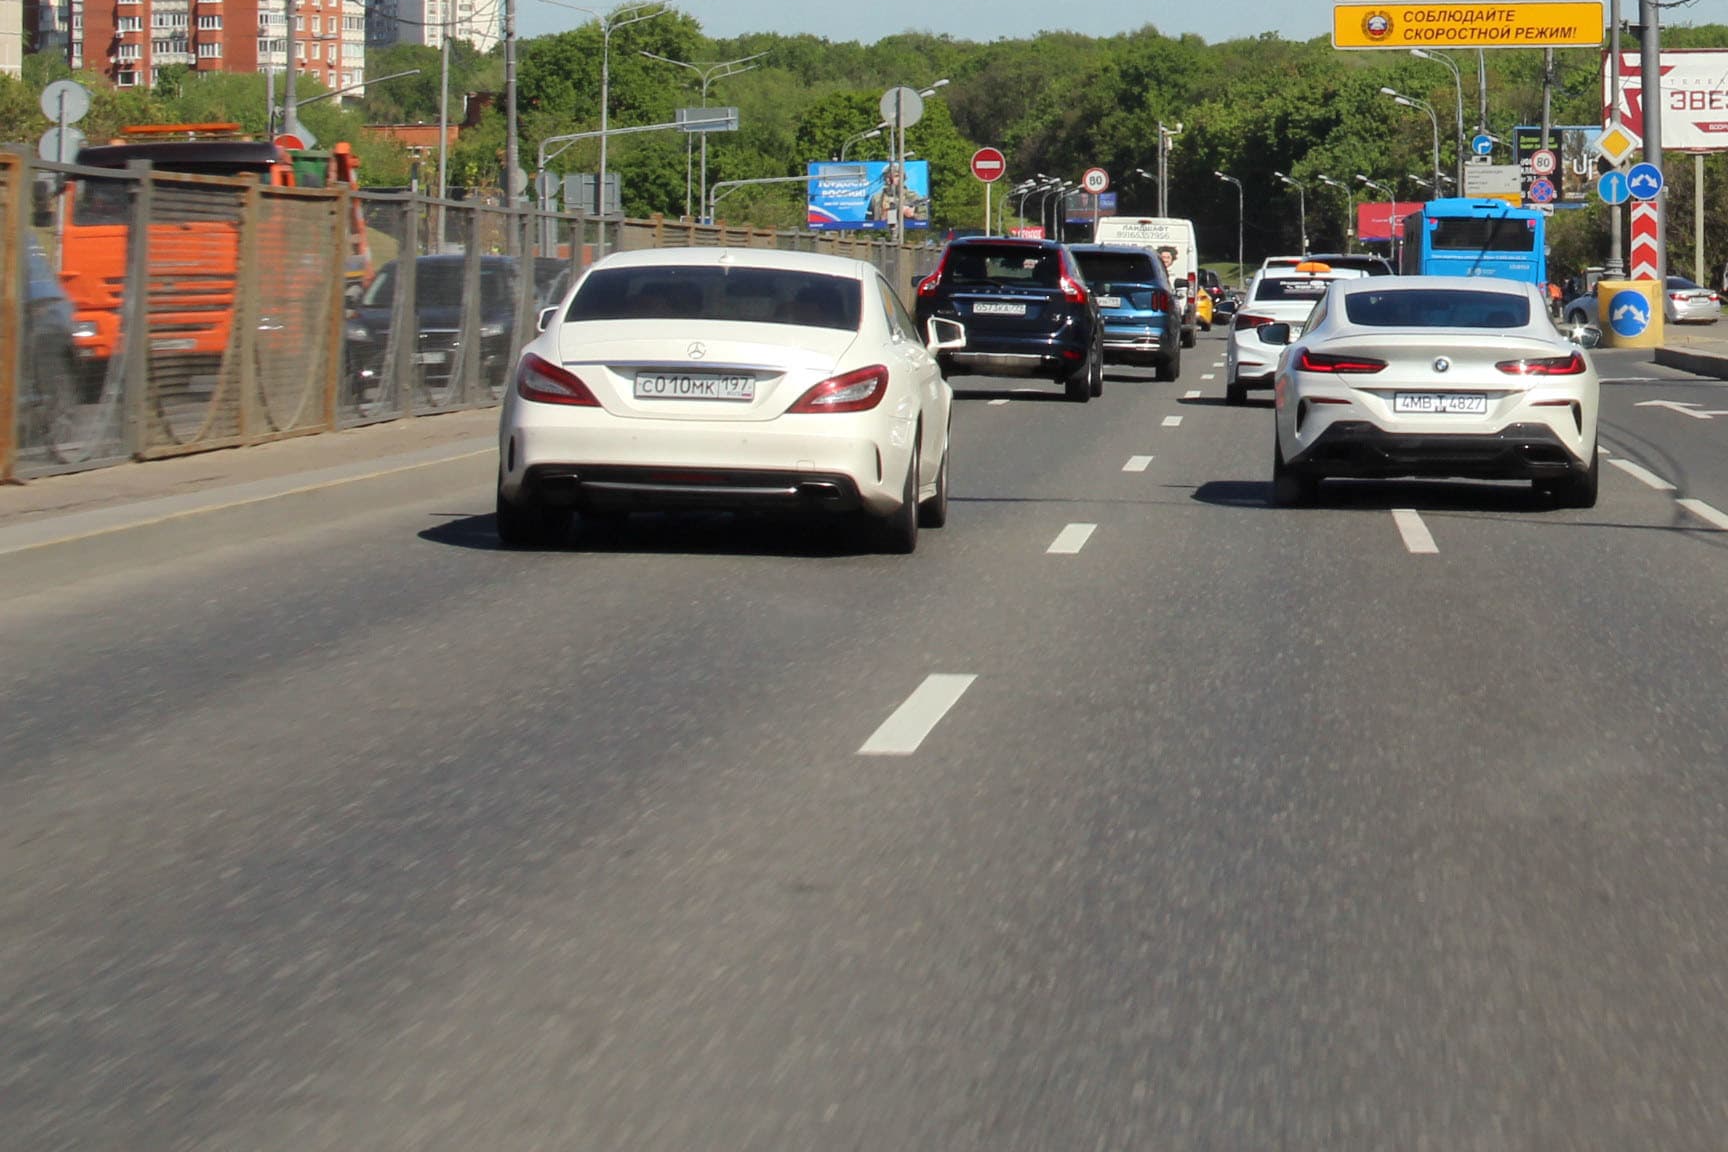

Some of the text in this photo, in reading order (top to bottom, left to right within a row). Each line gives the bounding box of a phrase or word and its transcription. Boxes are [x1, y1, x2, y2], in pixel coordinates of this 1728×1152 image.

[1403, 8, 1516, 24] СОБЛЮДАЙТЕ
[1403, 26, 1577, 40] СКОРОСТНОЙ РЕЖИМ!
[1536, 157, 1550, 168] 80
[1089, 175, 1103, 185] 80
[721, 376, 749, 391] 197
